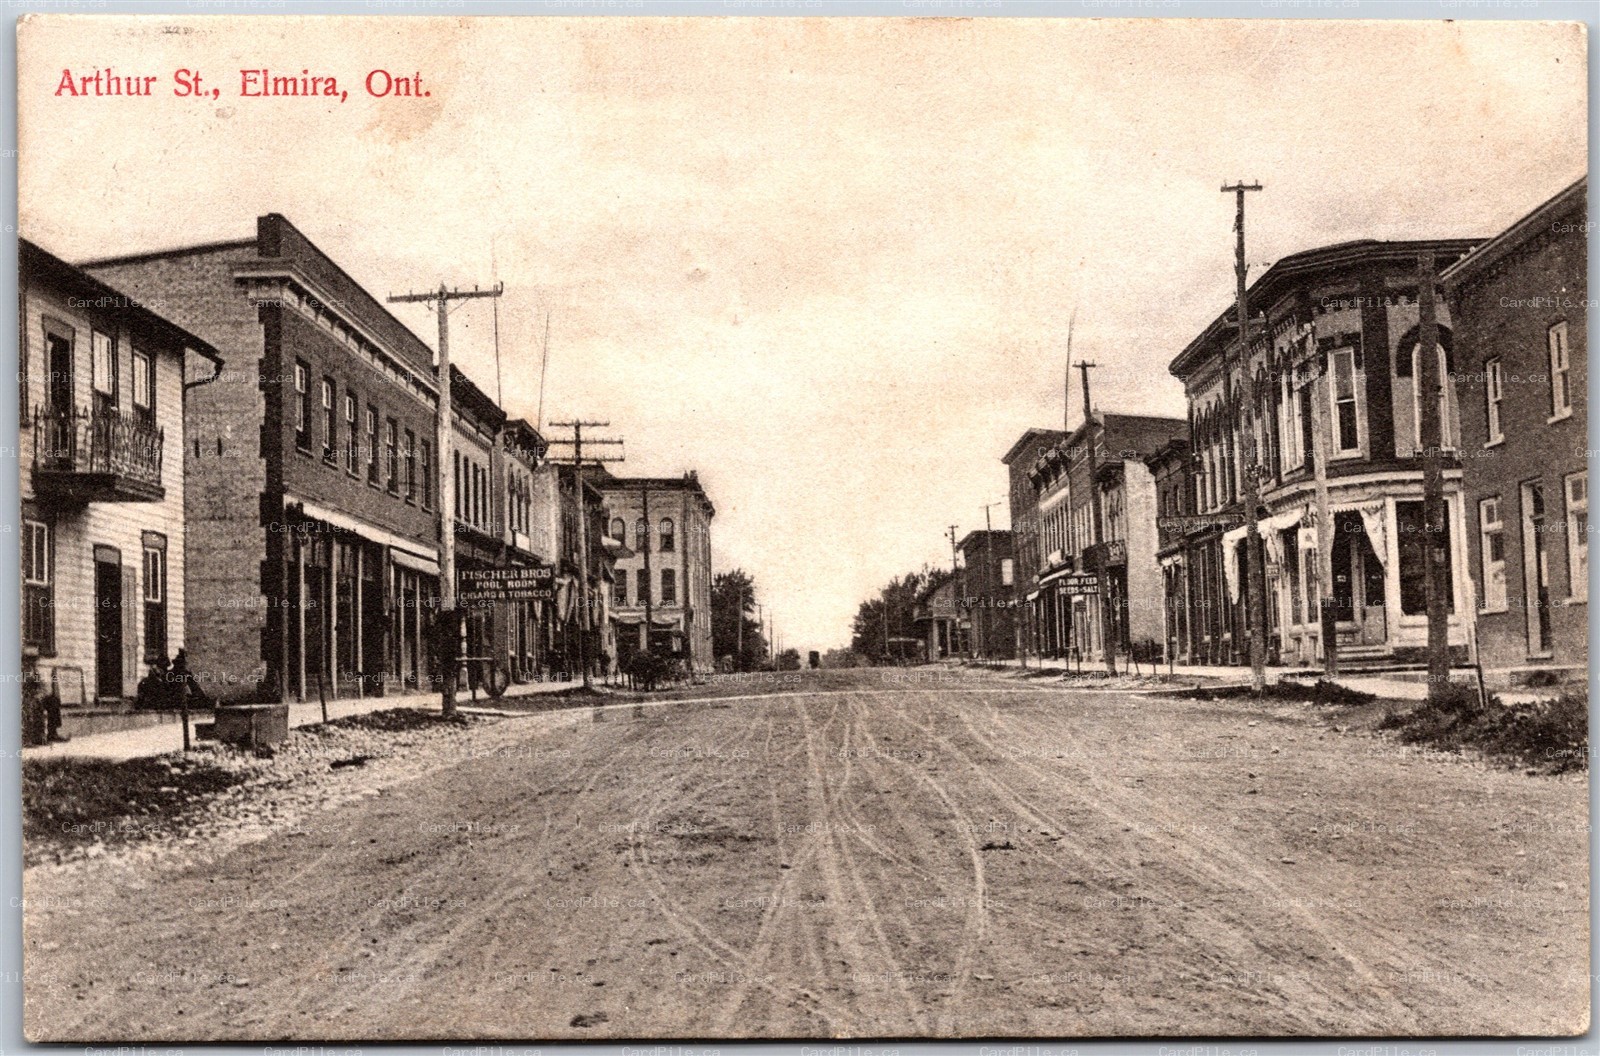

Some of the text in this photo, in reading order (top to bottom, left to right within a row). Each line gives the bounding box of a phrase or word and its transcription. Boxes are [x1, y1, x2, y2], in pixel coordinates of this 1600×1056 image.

[461, 568, 552, 580] FISCHER BROS
[475, 579, 537, 589] POOL ROOM
